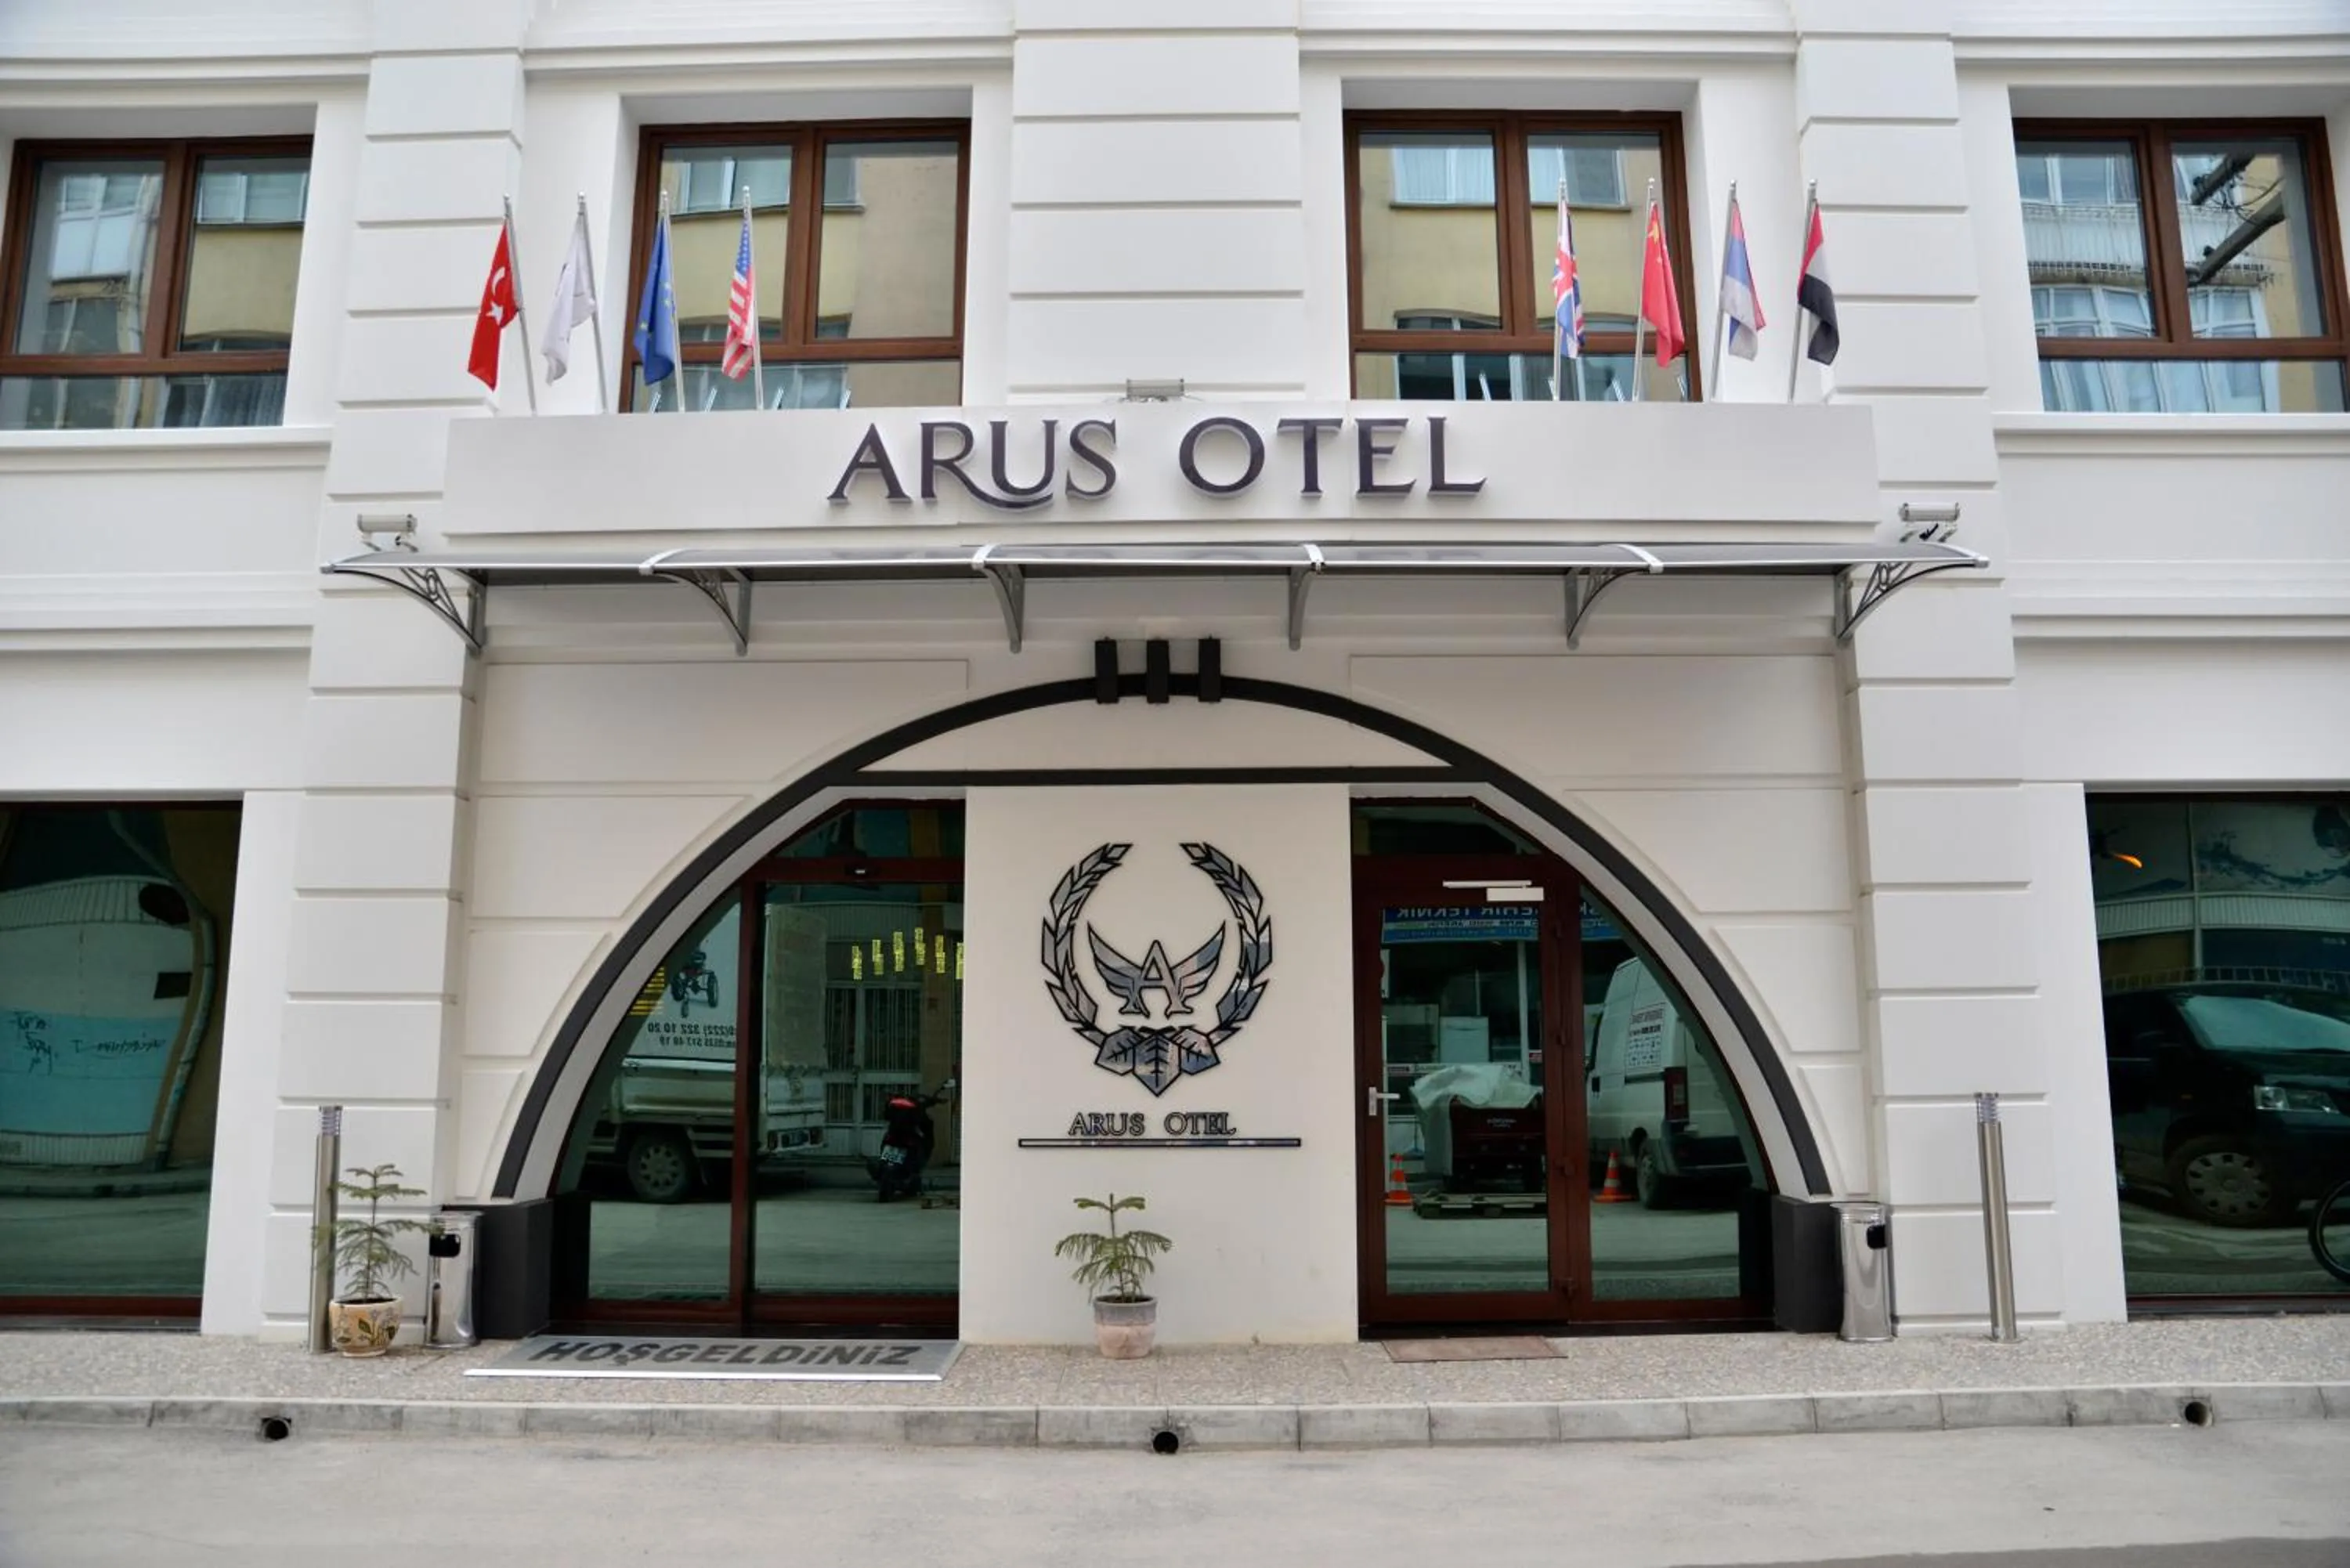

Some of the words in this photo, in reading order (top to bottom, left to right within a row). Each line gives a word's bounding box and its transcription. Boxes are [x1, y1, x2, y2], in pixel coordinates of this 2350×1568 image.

[827, 420, 1117, 511] ARUS
[1179, 417, 1487, 498] OTEL
[1068, 1111, 1145, 1136] ARUS
[1163, 1111, 1237, 1136] OTEL
